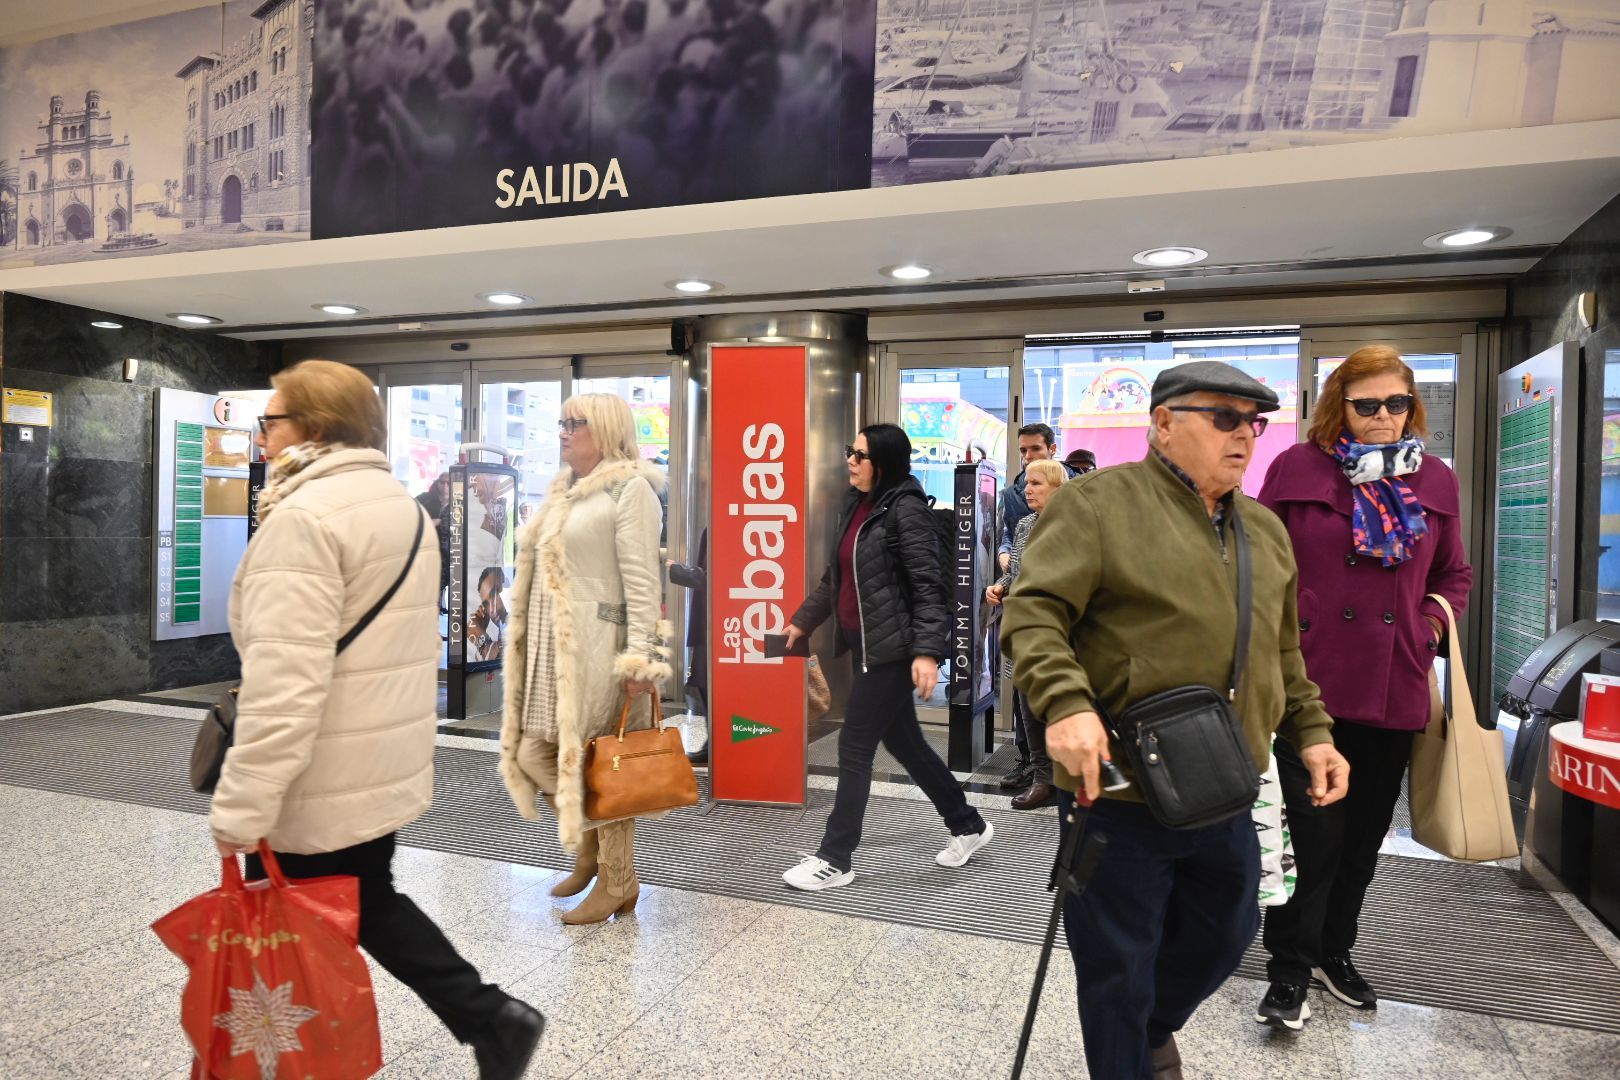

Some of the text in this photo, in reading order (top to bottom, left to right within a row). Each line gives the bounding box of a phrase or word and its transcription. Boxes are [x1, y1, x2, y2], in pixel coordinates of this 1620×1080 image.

[495, 157, 629, 209] SALIDA
[160, 536, 172, 547] PB
[729, 422, 798, 665] rebajas
[160, 567, 171, 577] S2
[160, 582, 171, 592] S3
[955, 494, 972, 683] TOMMY HILFIGER
[160, 597, 171, 607] S4
[451, 577, 461, 646] TOMMY
[160, 612, 171, 622] S5
[718, 616, 741, 664] Las
